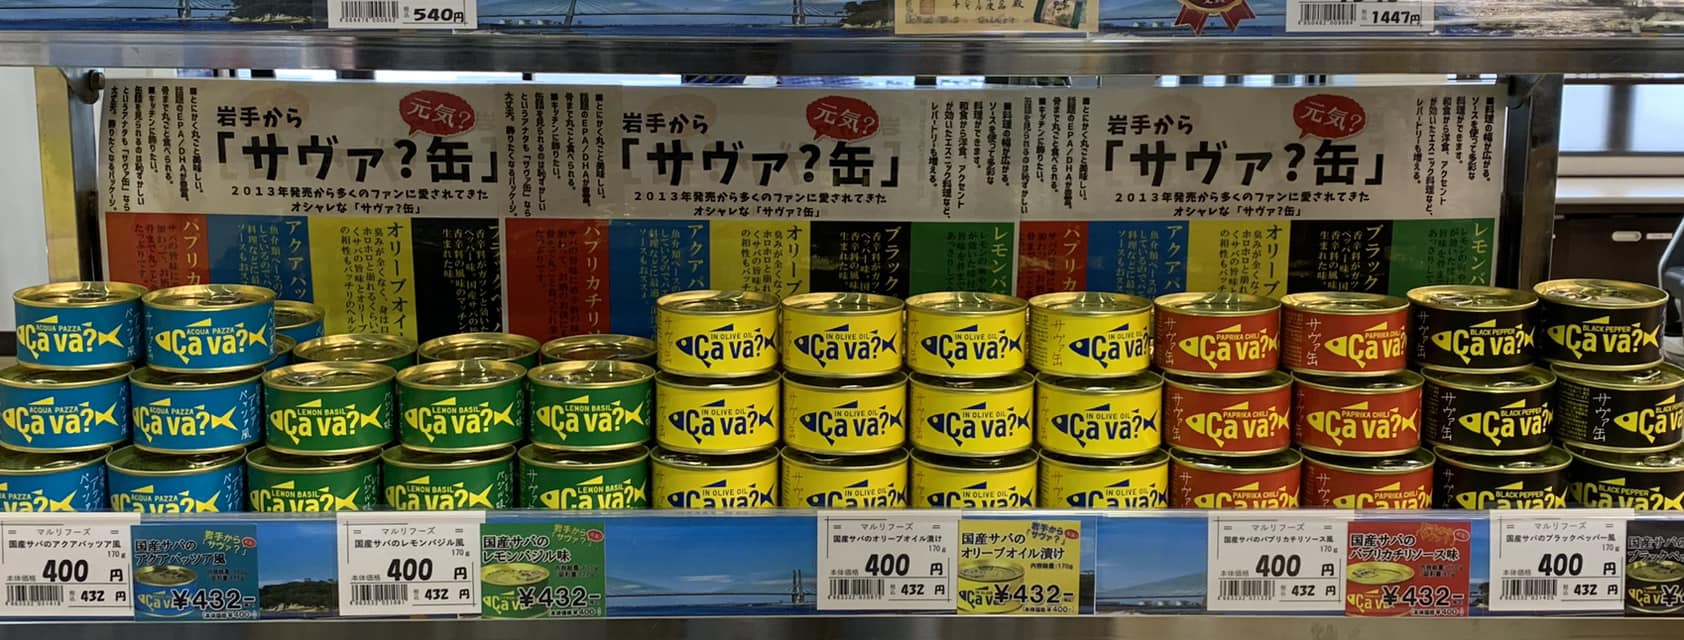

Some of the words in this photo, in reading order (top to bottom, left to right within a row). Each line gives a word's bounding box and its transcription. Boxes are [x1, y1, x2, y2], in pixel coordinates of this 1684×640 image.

[216, 105, 303, 128] 岩手から
[407, 97, 472, 128] 元気?
[622, 112, 708, 135] 岩手から
[815, 103, 874, 132] 元気?
[1304, 102, 1364, 132] 元気?
[1107, 113, 1194, 136] 岩手から
[387, 222, 408, 337] オリーブオイ
[584, 224, 602, 334] パプリカチリ
[56, 325, 81, 333] PAZZA
[187, 327, 208, 335] ACQUA
[209, 326, 235, 334] PAZZA
[711, 332, 719, 340] IN
[720, 332, 742, 340] OLIVE
[742, 331, 754, 339] OIL
[1216, 332, 1243, 341] PAPRIKA
[1244, 331, 1260, 340] CHILI
[1470, 328, 1491, 336] BLACK
[1492, 327, 1515, 336] PEPPER
[54, 329, 98, 353] va?
[208, 330, 247, 354] va?
[729, 334, 764, 359] va?
[844, 335, 881, 360] va?
[973, 335, 1009, 360] va?
[1236, 333, 1269, 360] va?
[1306, 318, 1322, 366] サヴァ缶
[1490, 330, 1524, 356] va?
[1603, 328, 1644, 354] va?
[297, 408, 322, 416] LEMON
[323, 408, 347, 416] BASIL
[564, 404, 590, 412] LEMON
[591, 403, 612, 412] BASIL
[1342, 409, 1369, 418] PAPRIKA
[1370, 409, 1390, 417] CHILI
[1441, 392, 1456, 441] サヴァ缶
[50, 408, 94, 434] va?
[168, 408, 210, 435] va?
[317, 409, 360, 436] va?
[452, 408, 493, 433] va?
[584, 406, 626, 433] va?
[720, 410, 758, 436] va?
[853, 411, 889, 437] va?
[982, 413, 1017, 438] va?
[1105, 415, 1143, 440] va?
[1244, 411, 1277, 438] va?
[1362, 413, 1401, 439] va?
[135, 539, 197, 552] 国産サバの
[483, 535, 549, 549] 国産サバの
[962, 533, 1026, 545] 国産サバの
[1351, 534, 1416, 547] 国産サバの
[483, 550, 571, 562] レモンバジル味
[961, 547, 1065, 559] オリーブオイル漬け
[1538, 553, 1584, 576] 400
[1603, 562, 1617, 576] 円
[43, 559, 89, 582] 400
[109, 568, 124, 582] 円
[387, 558, 433, 581] 400
[454, 567, 467, 580] 円
[865, 554, 910, 576] 400
[930, 563, 943, 575] 円
[1256, 554, 1301, 577] 400
[1321, 563, 1334, 576] 円
[80, 590, 105, 602] 432
[115, 591, 127, 602] 円
[425, 589, 449, 600] 432
[459, 589, 470, 600] 円
[901, 584, 924, 595] 432
[935, 585, 945, 595] 円
[1291, 585, 1315, 596] 432
[1325, 585, 1336, 596] 円
[1574, 584, 1598, 595] 432
[1607, 584, 1618, 595] 円
